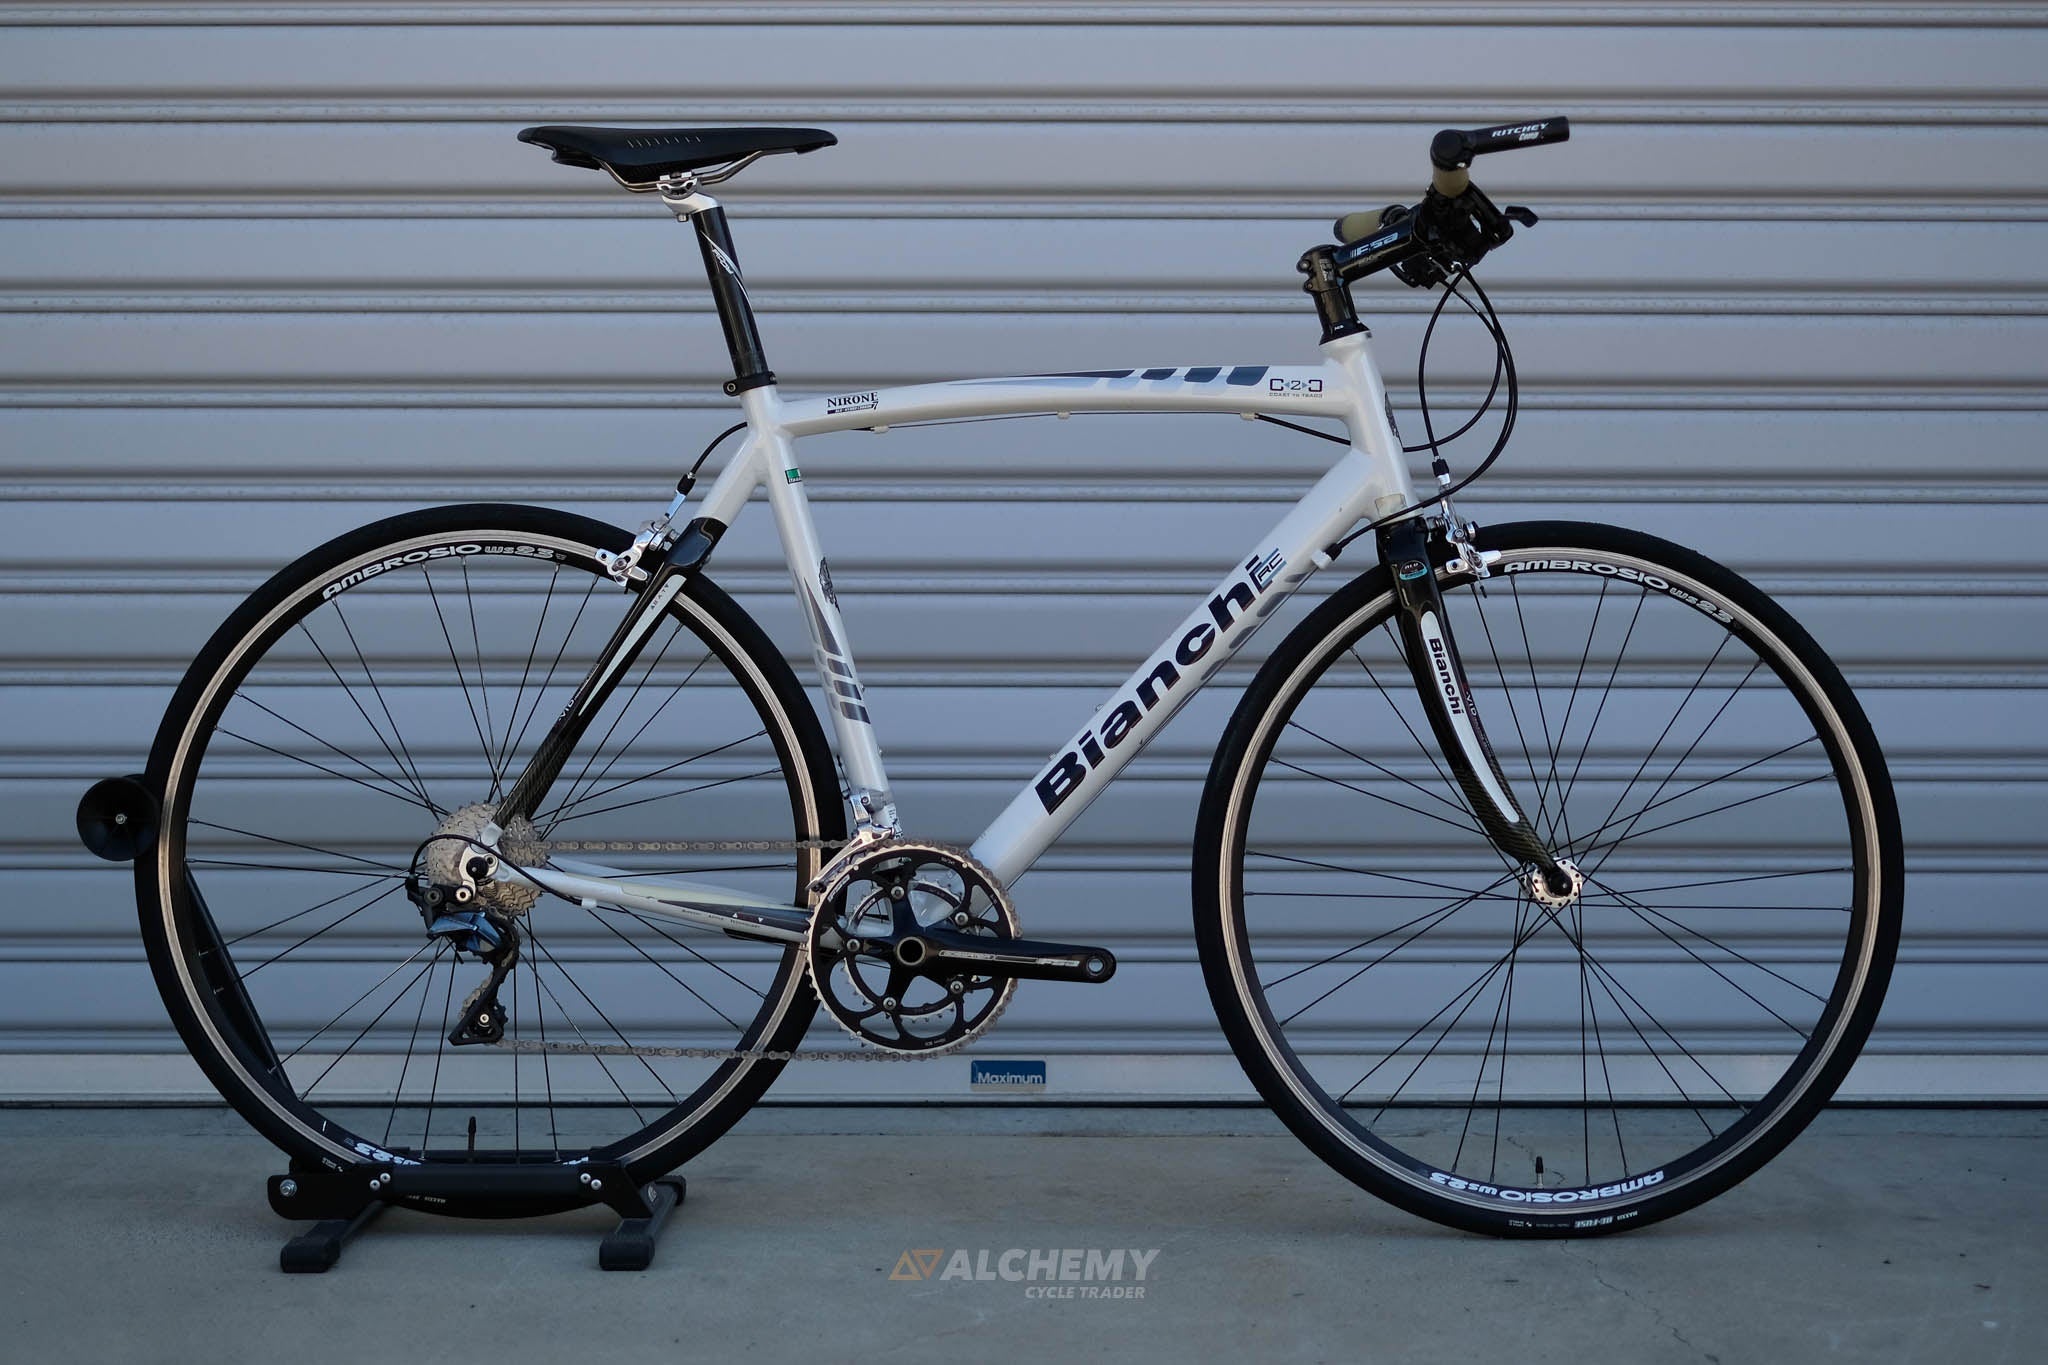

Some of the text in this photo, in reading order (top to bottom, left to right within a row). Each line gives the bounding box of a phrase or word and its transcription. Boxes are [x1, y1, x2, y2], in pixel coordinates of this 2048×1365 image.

[1491, 122, 1549, 138] RITCHEY
[827, 391, 879, 408] NIRONE
[323, 544, 482, 601] AMBROSIO
[1504, 559, 1669, 590] AMBROSIO
[1035, 555, 1272, 815] Bianchi
[1430, 638, 1465, 715] Bianchi
[977, 1072, 1043, 1085] Maximum
[1500, 1170, 1665, 1203] AMBROSIO
